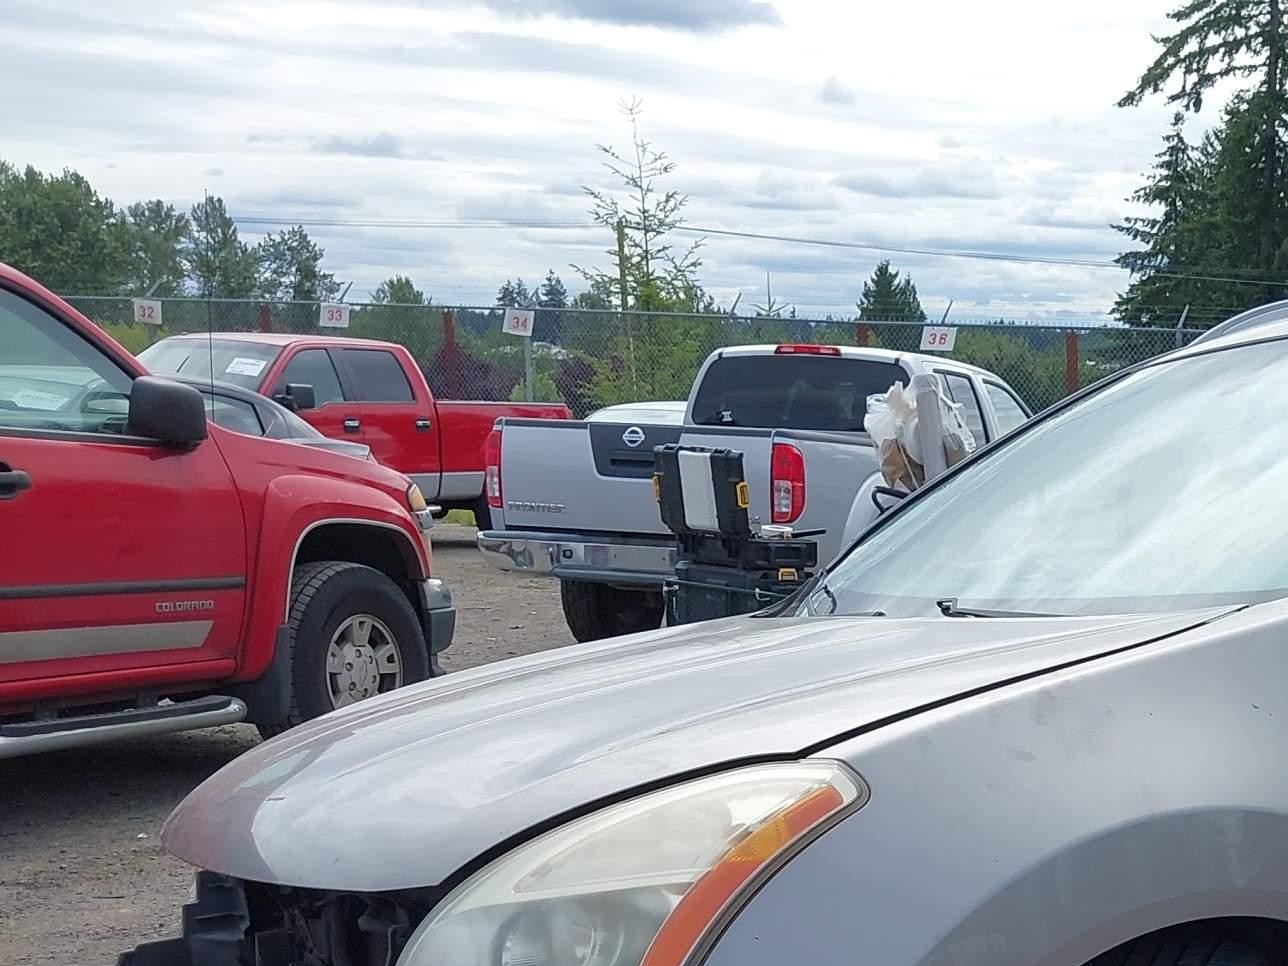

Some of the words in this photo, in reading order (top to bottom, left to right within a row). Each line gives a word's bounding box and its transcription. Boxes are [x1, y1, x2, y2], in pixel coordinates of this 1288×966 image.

[139, 306, 154, 319] 32
[327, 310, 342, 322] 33
[512, 316, 528, 329] 34
[928, 333, 948, 345] 36
[155, 600, 214, 612] COLORADO
